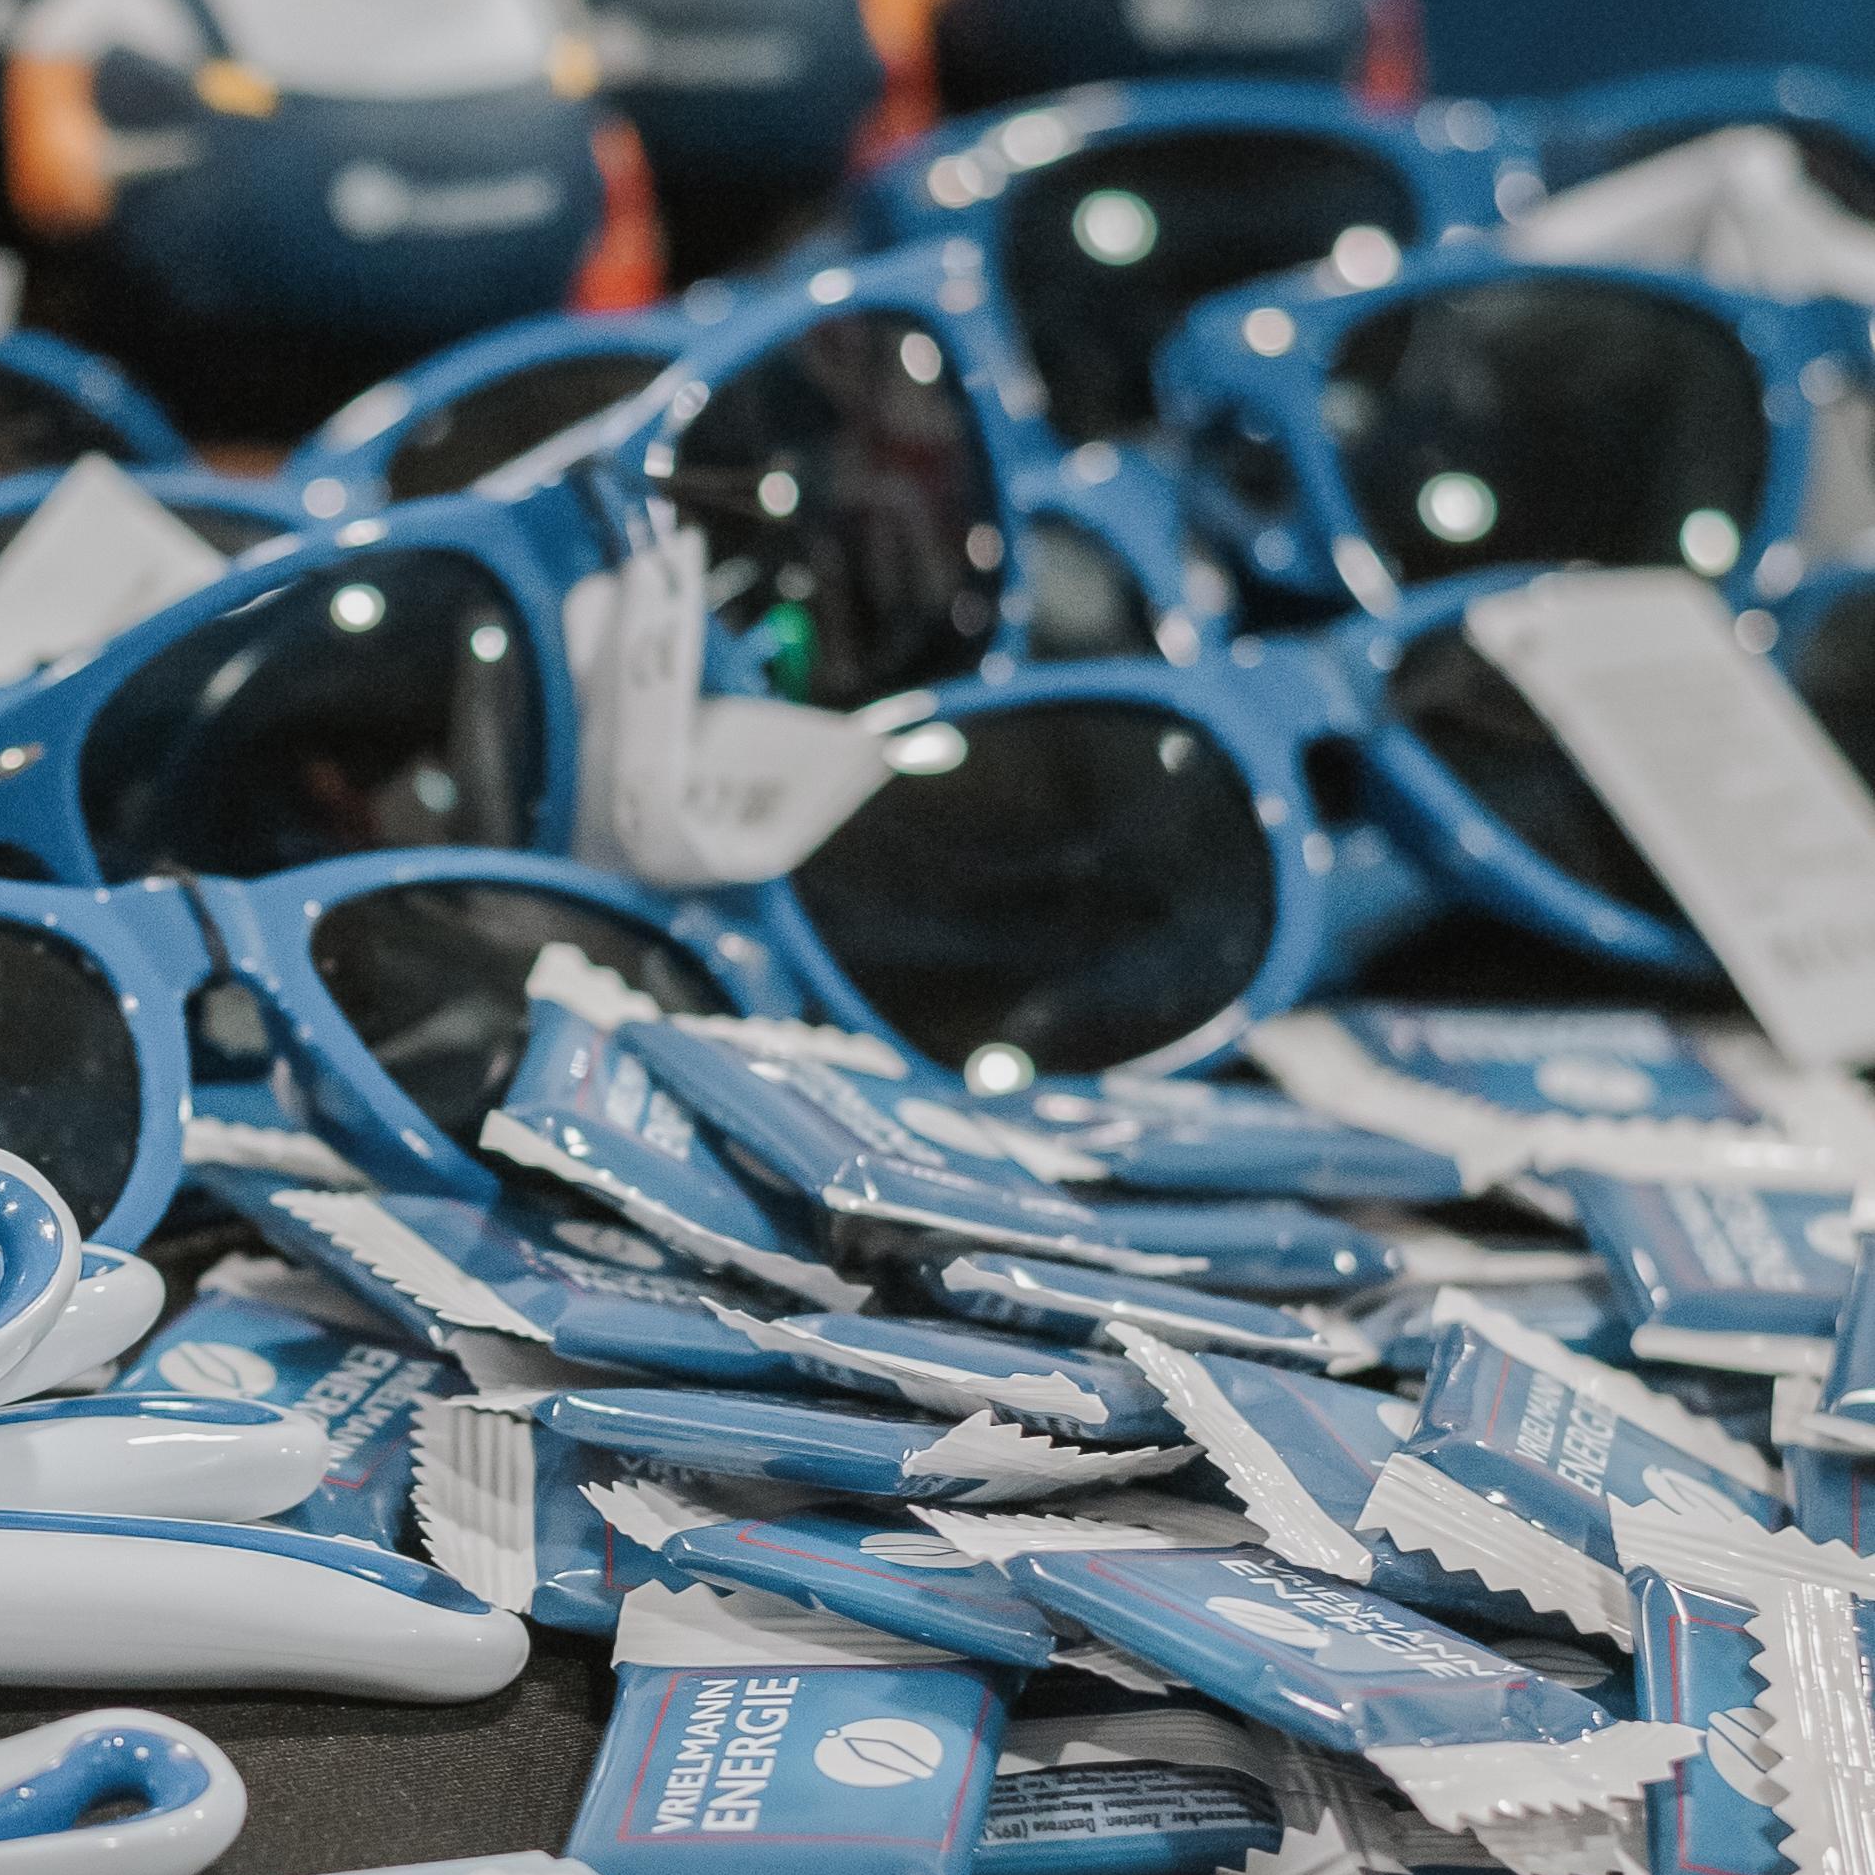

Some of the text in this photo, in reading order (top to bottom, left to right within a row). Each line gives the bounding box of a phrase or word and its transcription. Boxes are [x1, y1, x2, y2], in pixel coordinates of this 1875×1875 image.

[1218, 1559, 1470, 1678] ENERGIE
[1261, 1557, 1528, 1677] VRIELMANN
[651, 1679, 738, 1834] VRIELMANN
[701, 1676, 800, 1832] ENERGIE
